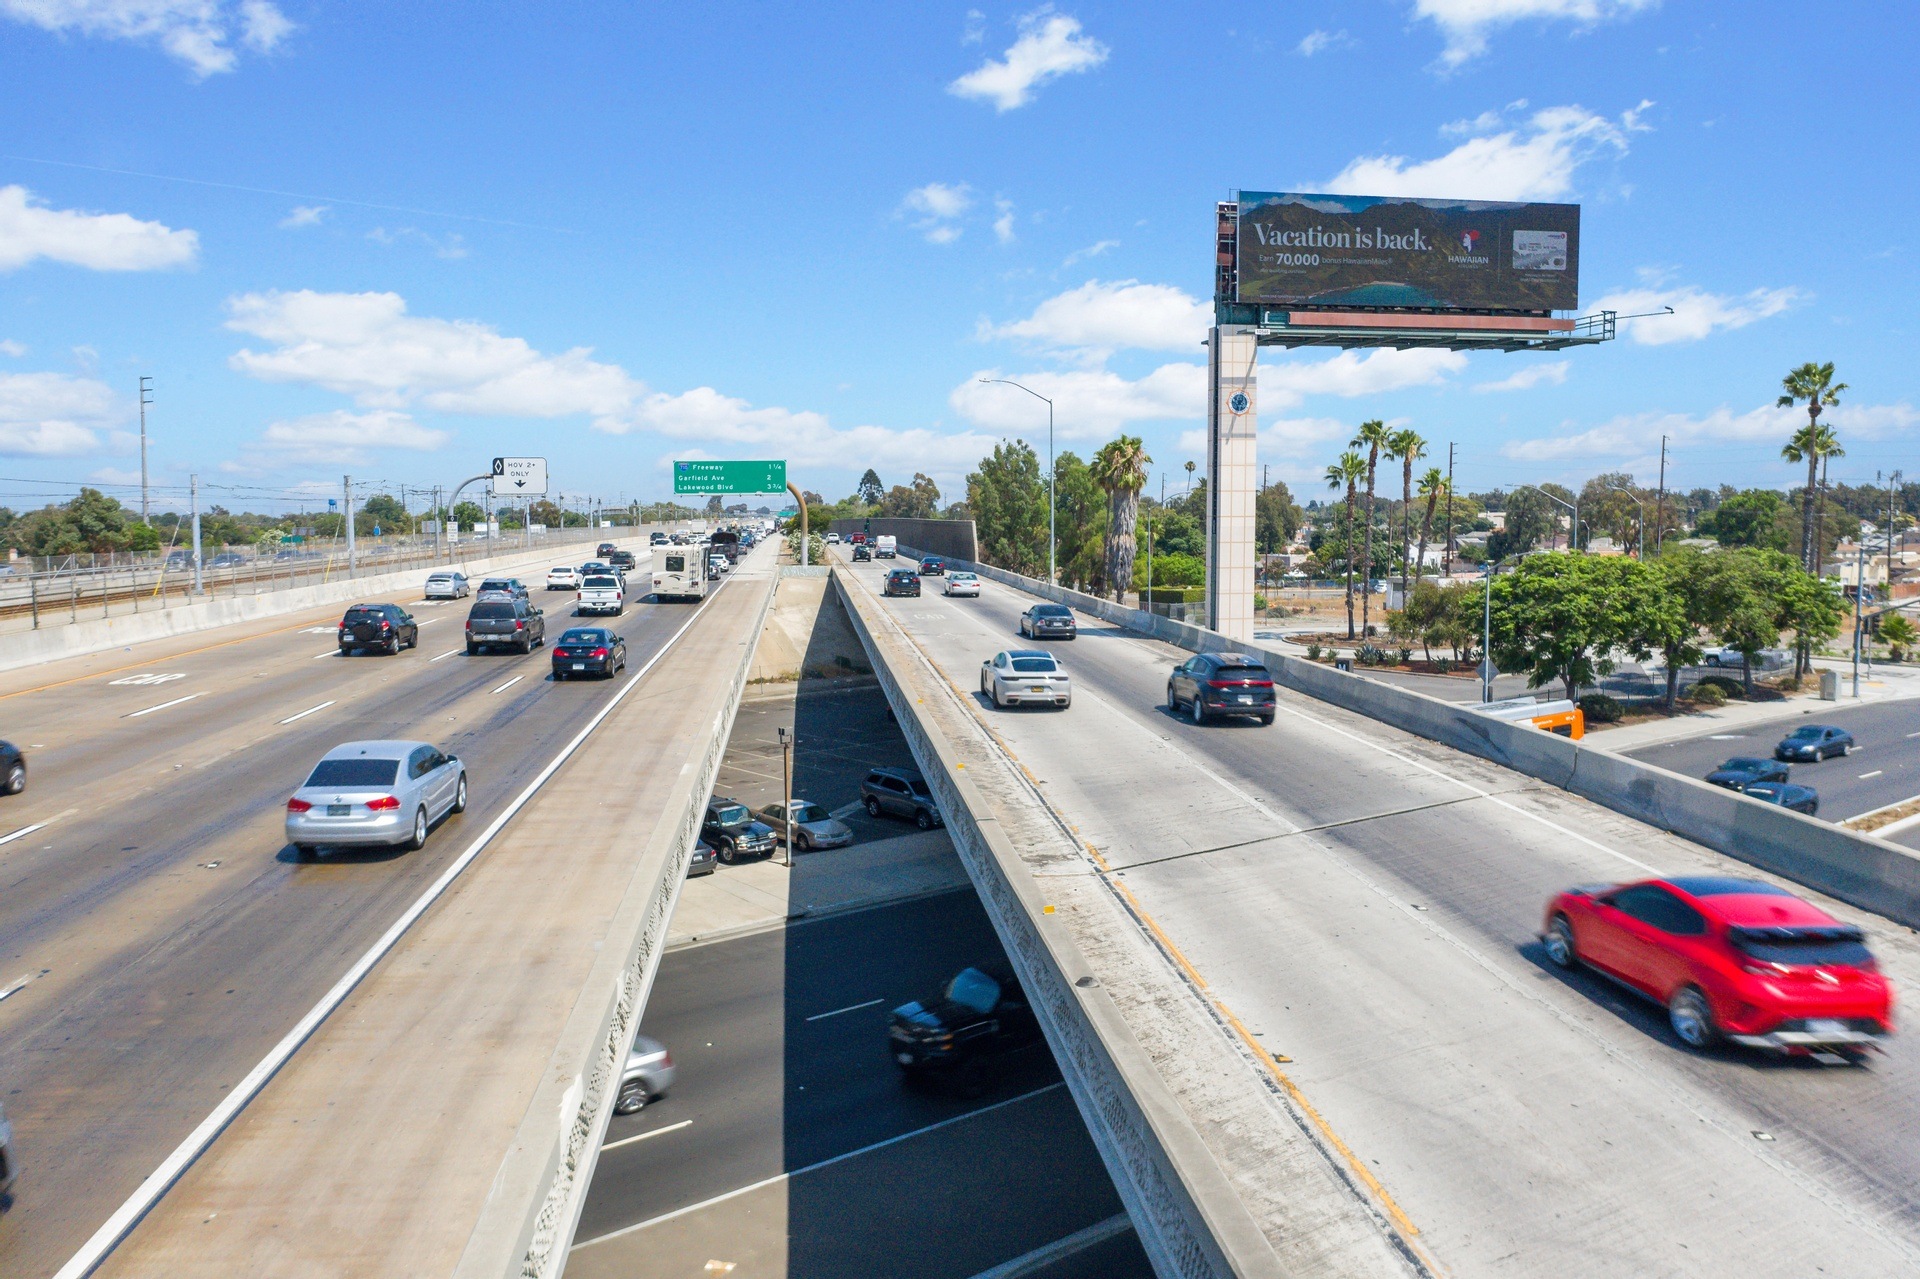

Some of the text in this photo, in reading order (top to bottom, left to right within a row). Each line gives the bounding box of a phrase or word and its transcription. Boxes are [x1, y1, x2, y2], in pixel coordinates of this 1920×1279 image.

[1253, 223, 1433, 251] Vacation is back.
[1259, 254, 1275, 262] Earn
[1275, 253, 1320, 267] 70,000
[1322, 256, 1342, 265] bonus
[1448, 255, 1489, 264] HAWAIIAN
